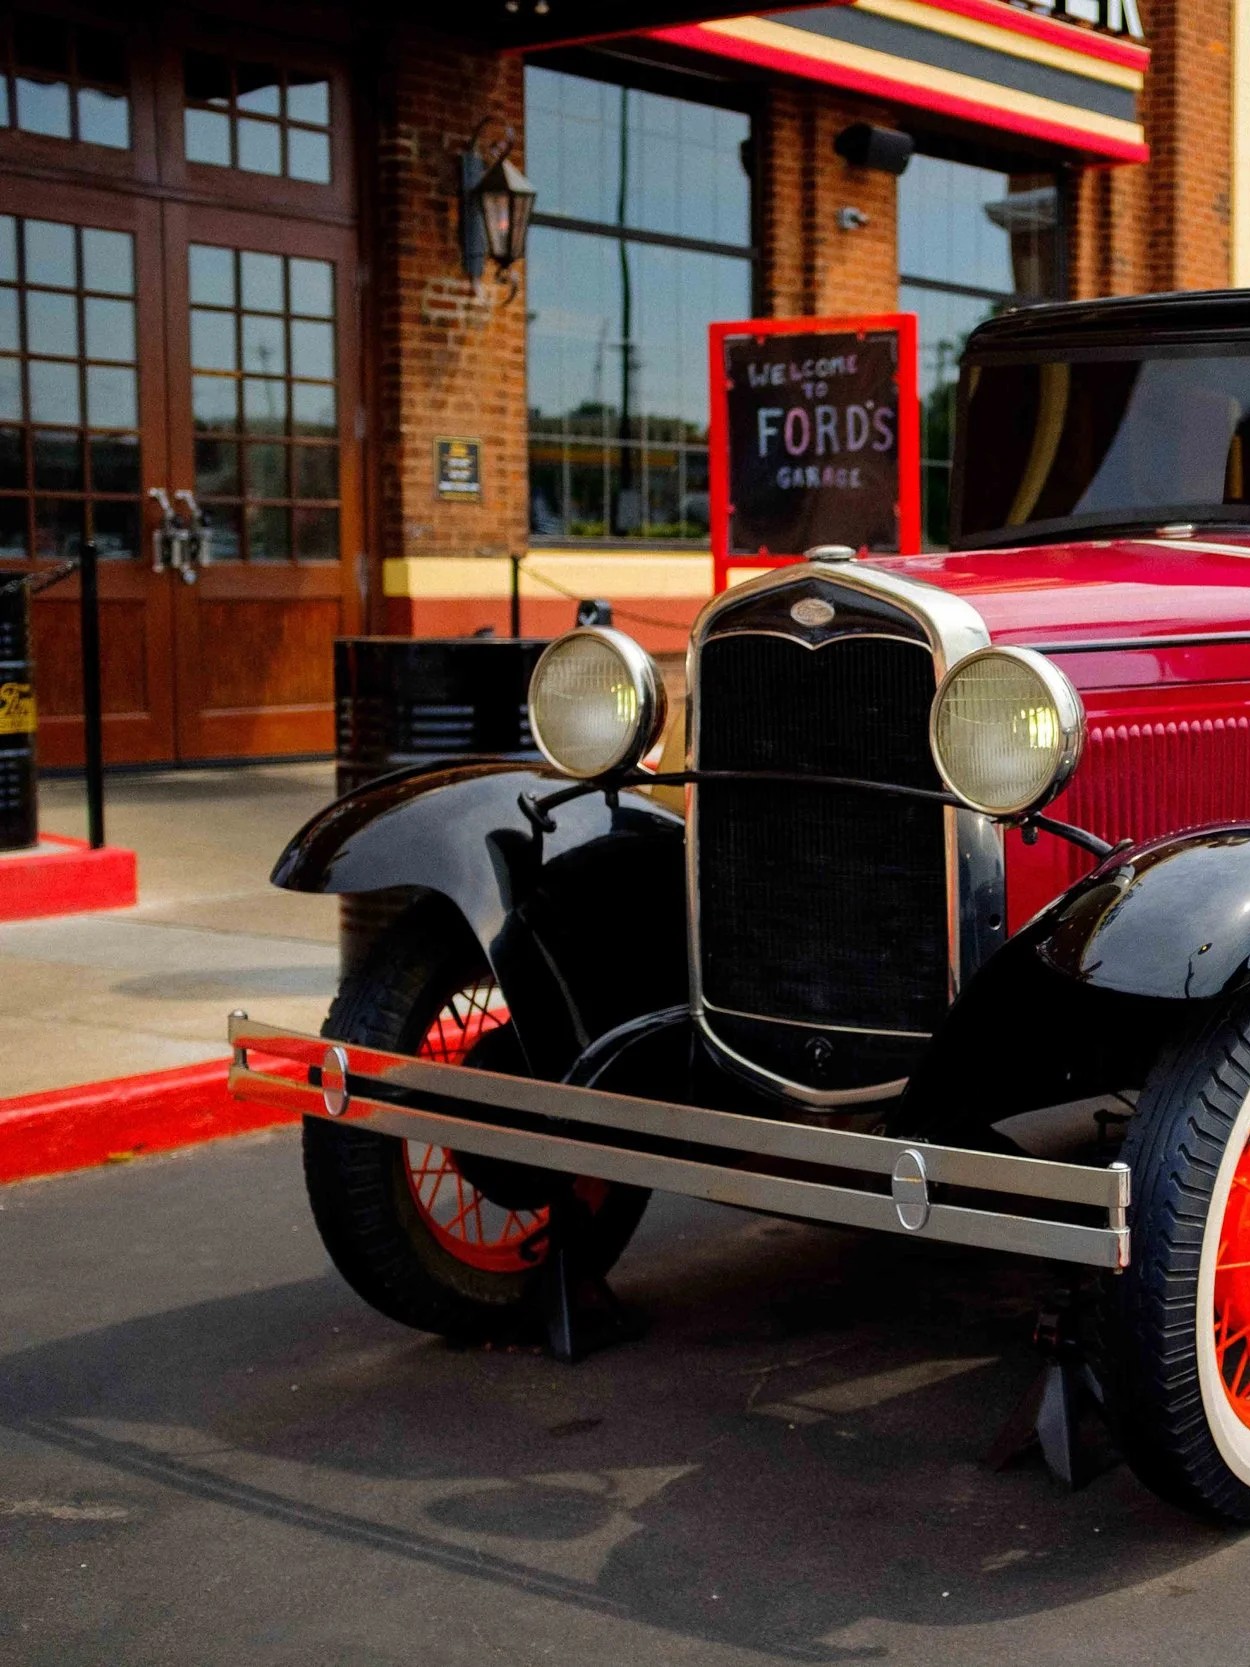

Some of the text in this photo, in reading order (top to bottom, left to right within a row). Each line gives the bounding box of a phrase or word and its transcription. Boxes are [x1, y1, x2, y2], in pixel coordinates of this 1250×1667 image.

[747, 354, 858, 387] WELCOME
[801, 381, 829, 399] TO
[757, 400, 896, 458] FORD'S
[775, 464, 862, 490] GARAGE
